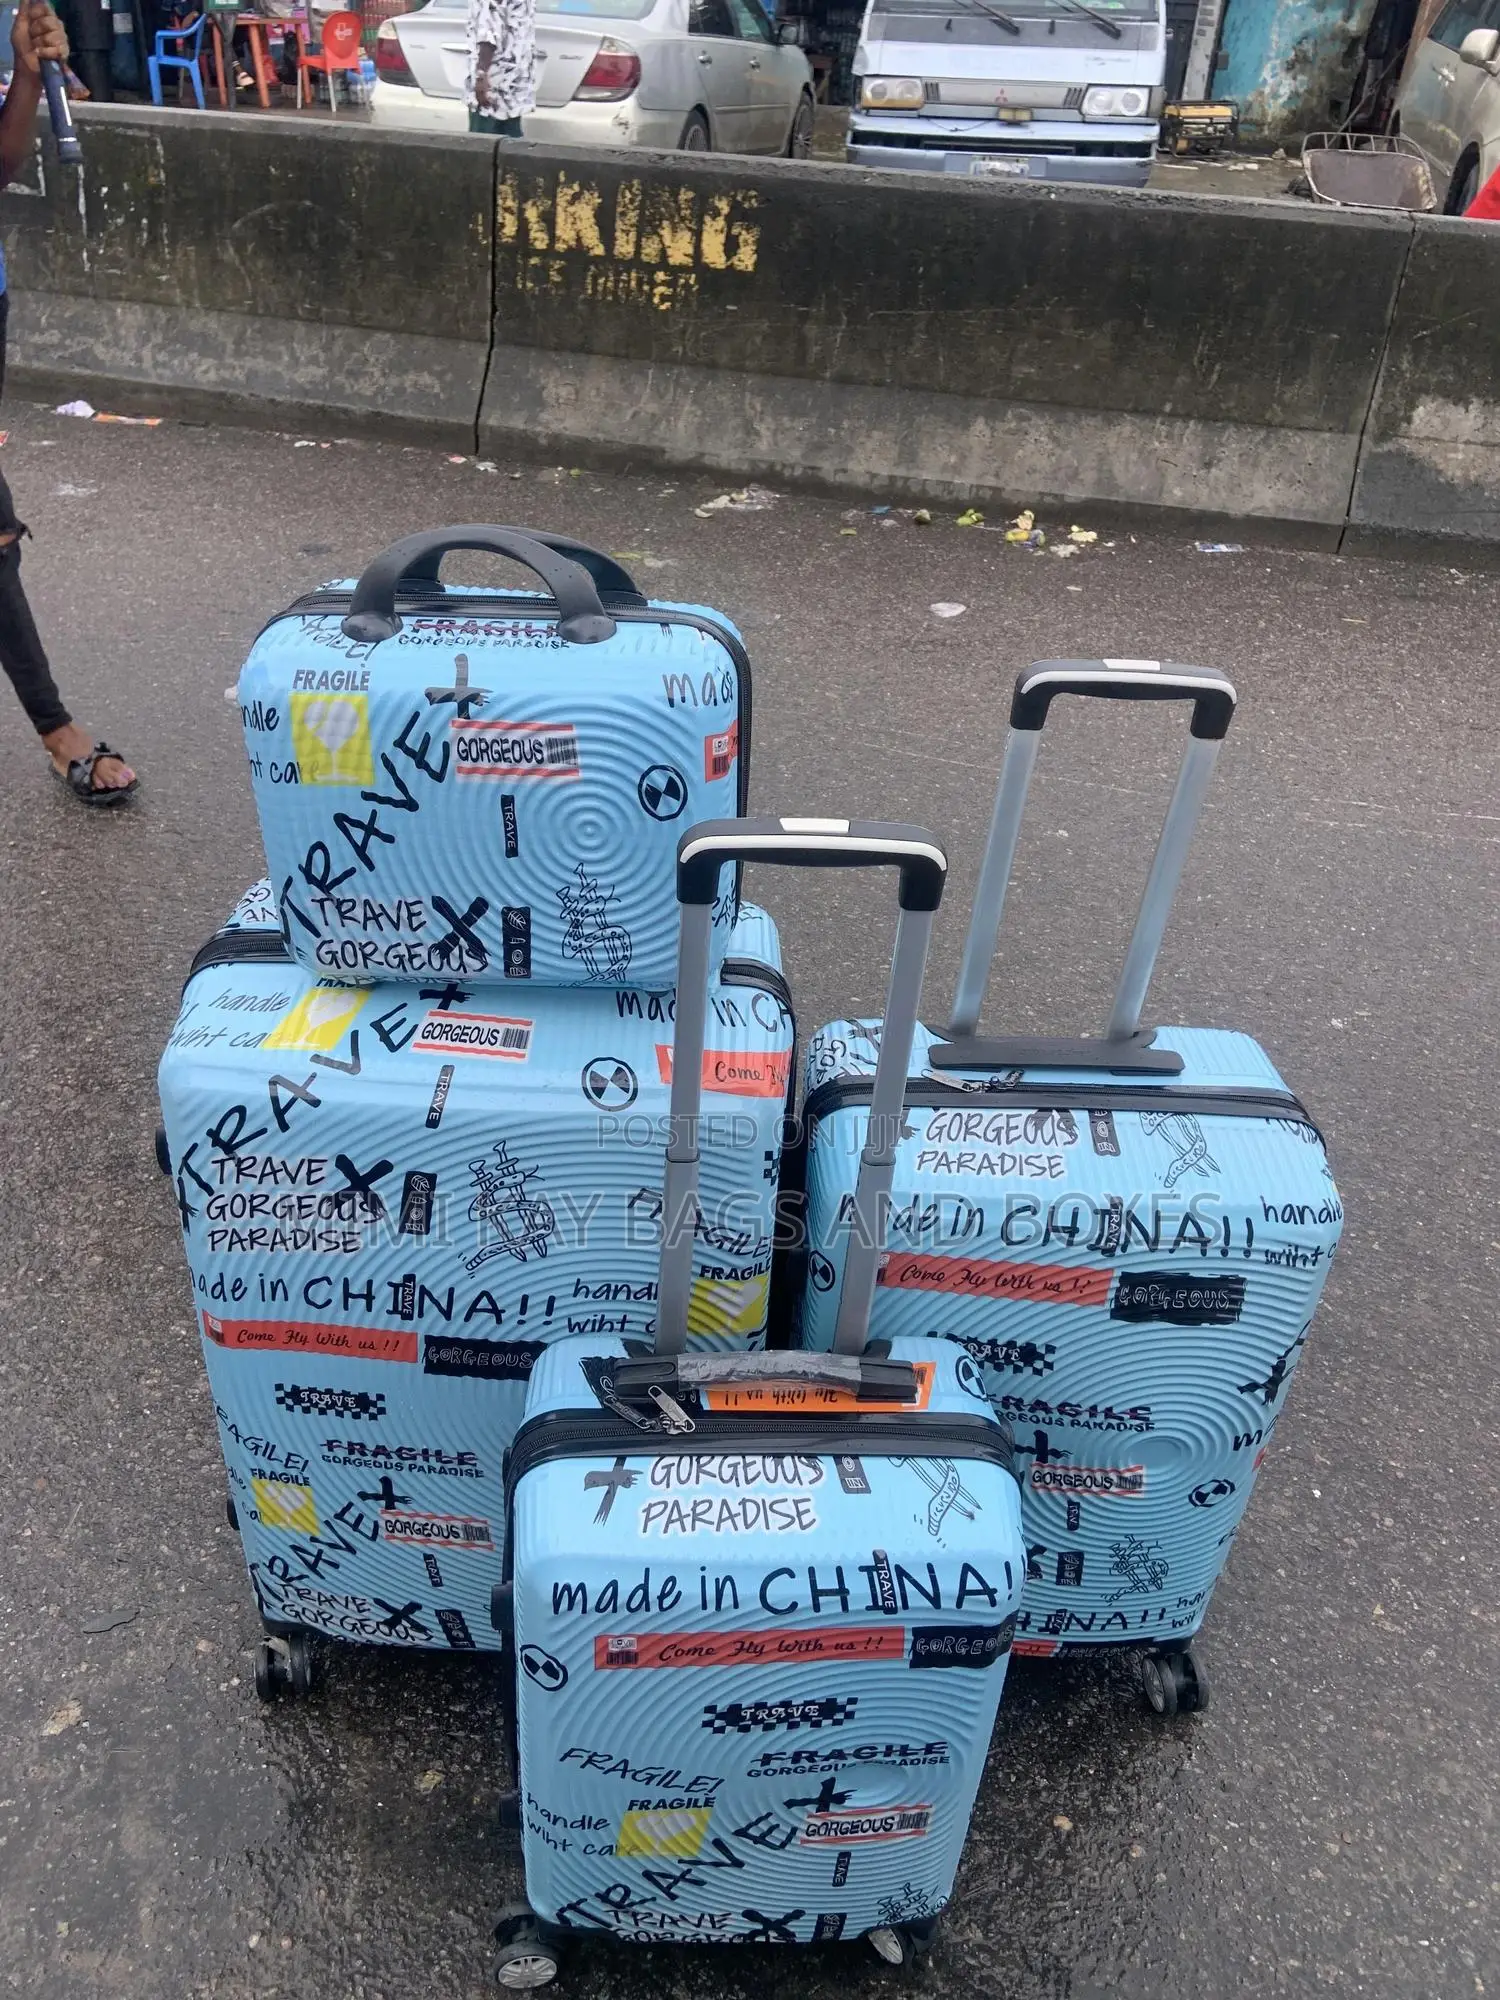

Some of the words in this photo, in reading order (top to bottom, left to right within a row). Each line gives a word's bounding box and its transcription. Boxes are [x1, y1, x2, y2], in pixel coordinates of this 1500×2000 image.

[292, 669, 371, 691] FRAGILE
[456, 736, 545, 765] GORGEOUS
[280, 711, 450, 938] TRAVE
[503, 802, 517, 849] TRAVE
[310, 897, 427, 932] TRAVE
[315, 939, 490, 974] GORGEOUS
[208, 988, 291, 1014] handle
[420, 1021, 501, 1047] GORGEOUS
[714, 1060, 764, 1083] Come
[177, 1003, 419, 1196] TRAVE
[427, 1072, 453, 1122] TRAVE
[926, 1111, 1079, 1147] GORGEOUS
[211, 1156, 328, 1185] TRAVE
[917, 1150, 1065, 1179] PARADISE
[206, 1193, 387, 1223] GORGEOUS
[950, 1198, 986, 1238] in
[1260, 1195, 1343, 1225] handle
[208, 1228, 361, 1253] PARADISE
[901, 1264, 945, 1283] Come
[259, 1273, 289, 1303] in
[1119, 1284, 1230, 1309] GORGEOUS
[567, 1314, 633, 1333] wiht
[237, 1329, 276, 1345] Come
[282, 1329, 309, 1347] Fly
[316, 1332, 352, 1350] With
[358, 1340, 378, 1351] us
[428, 1346, 534, 1369] GORGEOUS
[300, 1391, 357, 1408] TRAVE
[1070, 1419, 1156, 1433] PARADISE
[321, 1454, 405, 1472] GORGEOUS
[408, 1463, 485, 1479] PARADISE
[324, 1439, 478, 1467] FRAGILE
[250, 1467, 311, 1487] FRAGILE
[650, 1455, 825, 1488] GORGEOUS
[1032, 1470, 1114, 1490] GORGEOUS
[384, 1519, 462, 1539] GORGEOUS
[641, 1497, 817, 1533] PARADISE
[277, 1583, 371, 1614] TRAVE
[552, 1567, 682, 1615] made
[700, 1565, 740, 1612] in
[876, 1562, 895, 1609] TRAVE
[658, 1642, 717, 1662] Come
[727, 1640, 765, 1658] Fly
[778, 1638, 824, 1653] With
[834, 1641, 857, 1651] us
[741, 1704, 820, 1721] TRAVE
[756, 1742, 948, 1768] FRAGILE
[559, 1747, 725, 1796] FRAGILE!
[526, 1792, 612, 1831] handle
[628, 1796, 716, 1811] FRAGILE
[527, 1815, 573, 1852] wiht
[805, 1816, 895, 1837] GORGEOUS
[557, 1812, 798, 1928] TRAVE
[604, 1909, 732, 1929] TRAVE
